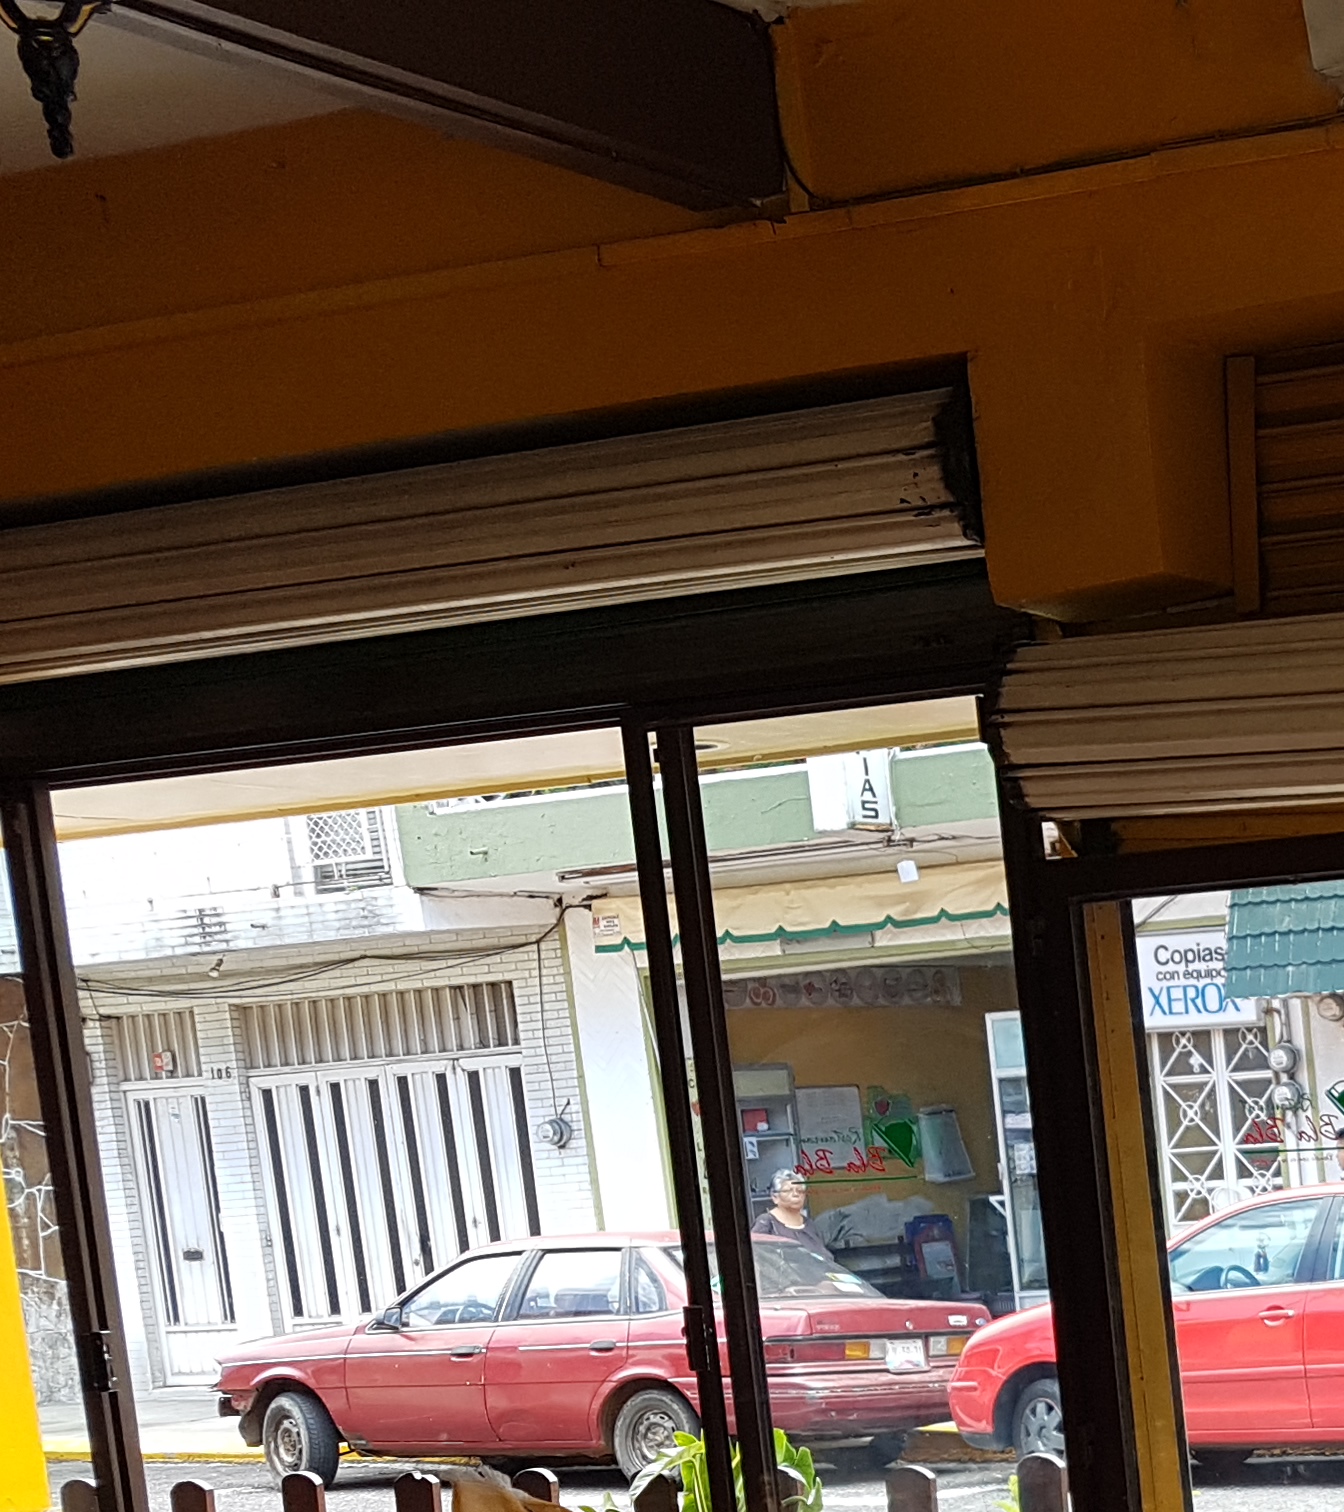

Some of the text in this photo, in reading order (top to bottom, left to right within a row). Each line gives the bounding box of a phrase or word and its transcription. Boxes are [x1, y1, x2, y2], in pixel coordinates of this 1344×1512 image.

[1153, 942, 1226, 968] Copias
[1155, 969, 1181, 982] con
[210, 1065, 232, 1080] 106
